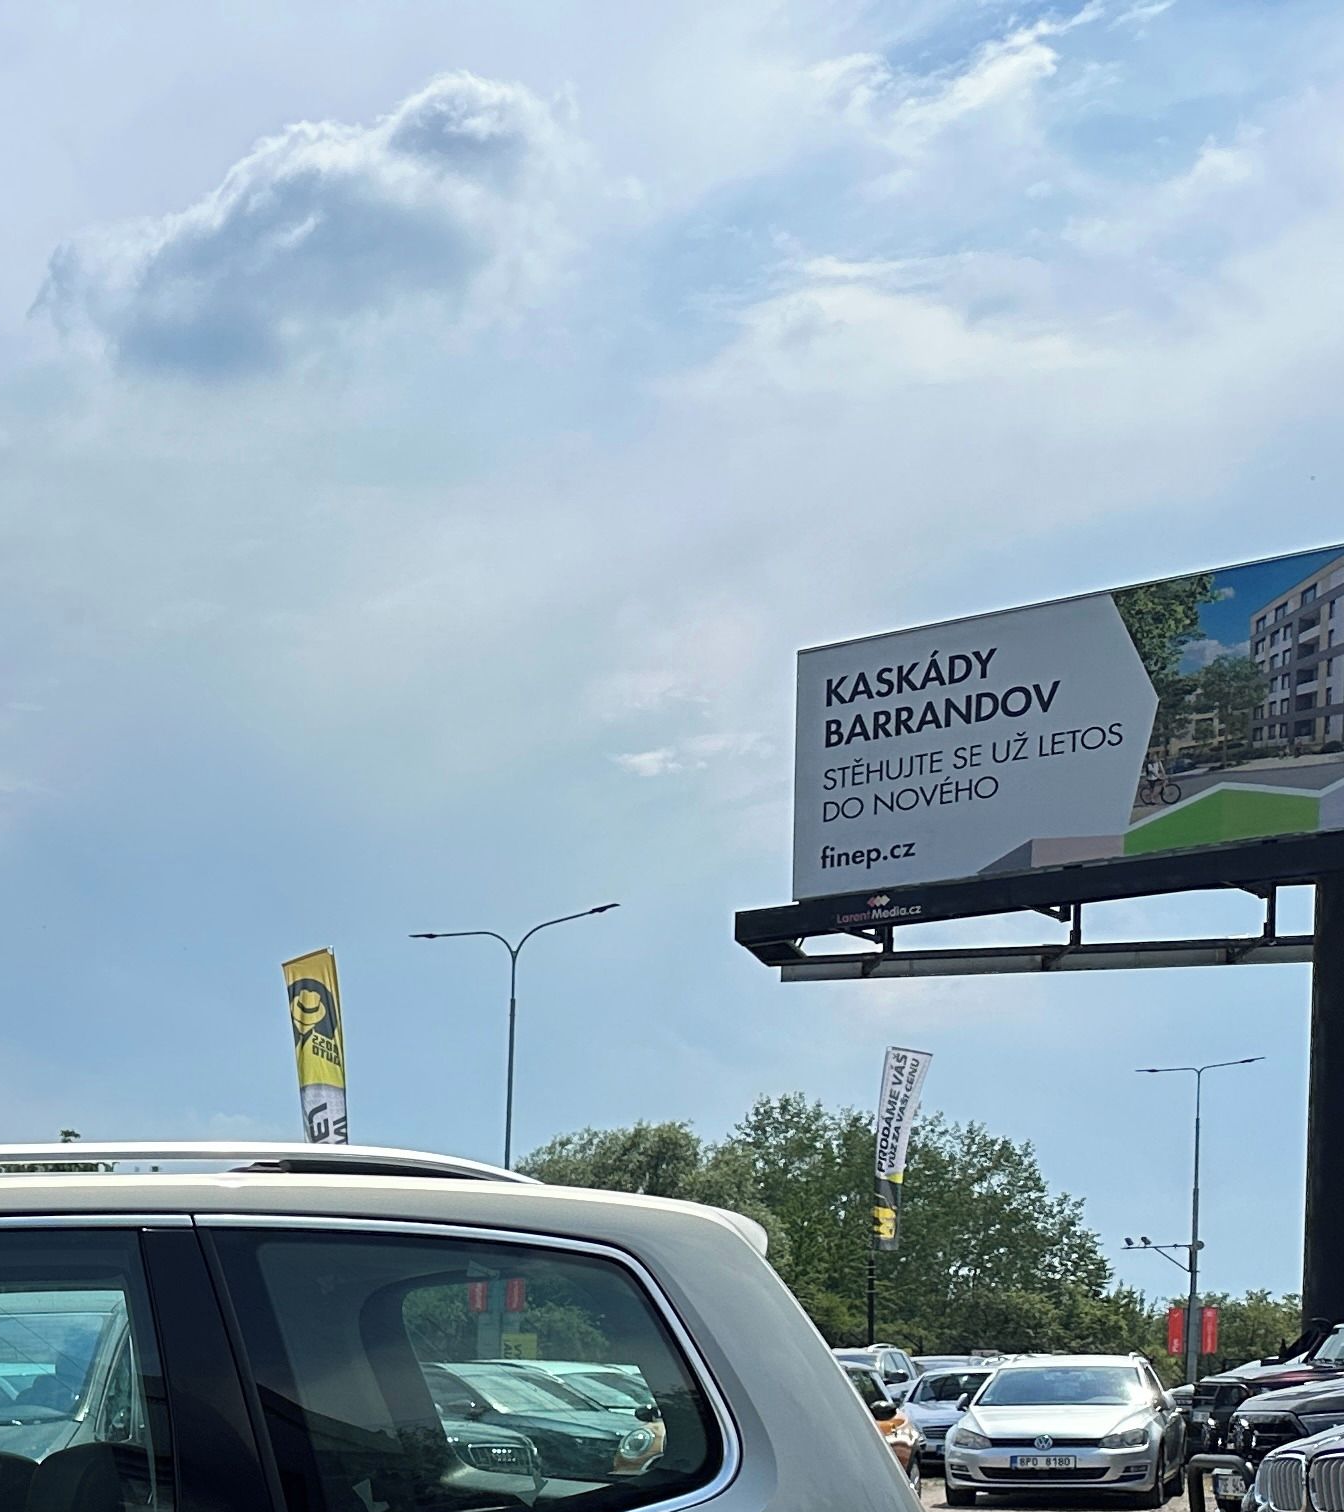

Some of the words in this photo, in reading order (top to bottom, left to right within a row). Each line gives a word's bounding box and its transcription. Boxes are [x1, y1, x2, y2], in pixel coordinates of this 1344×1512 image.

[825, 647, 998, 708] KASKÁDY
[824, 680, 1061, 749] BARRANDOV
[822, 750, 943, 791] STĚHUJTE
[952, 744, 984, 771] SE
[991, 731, 1029, 763] UŽ
[1038, 722, 1124, 759] LETOS
[822, 796, 864, 823] DO
[873, 775, 999, 816] NOVÉHO
[819, 841, 917, 870] finep.cz
[877, 1088, 900, 1173] PRODÁME
[890, 1052, 908, 1086] VÁŠ
